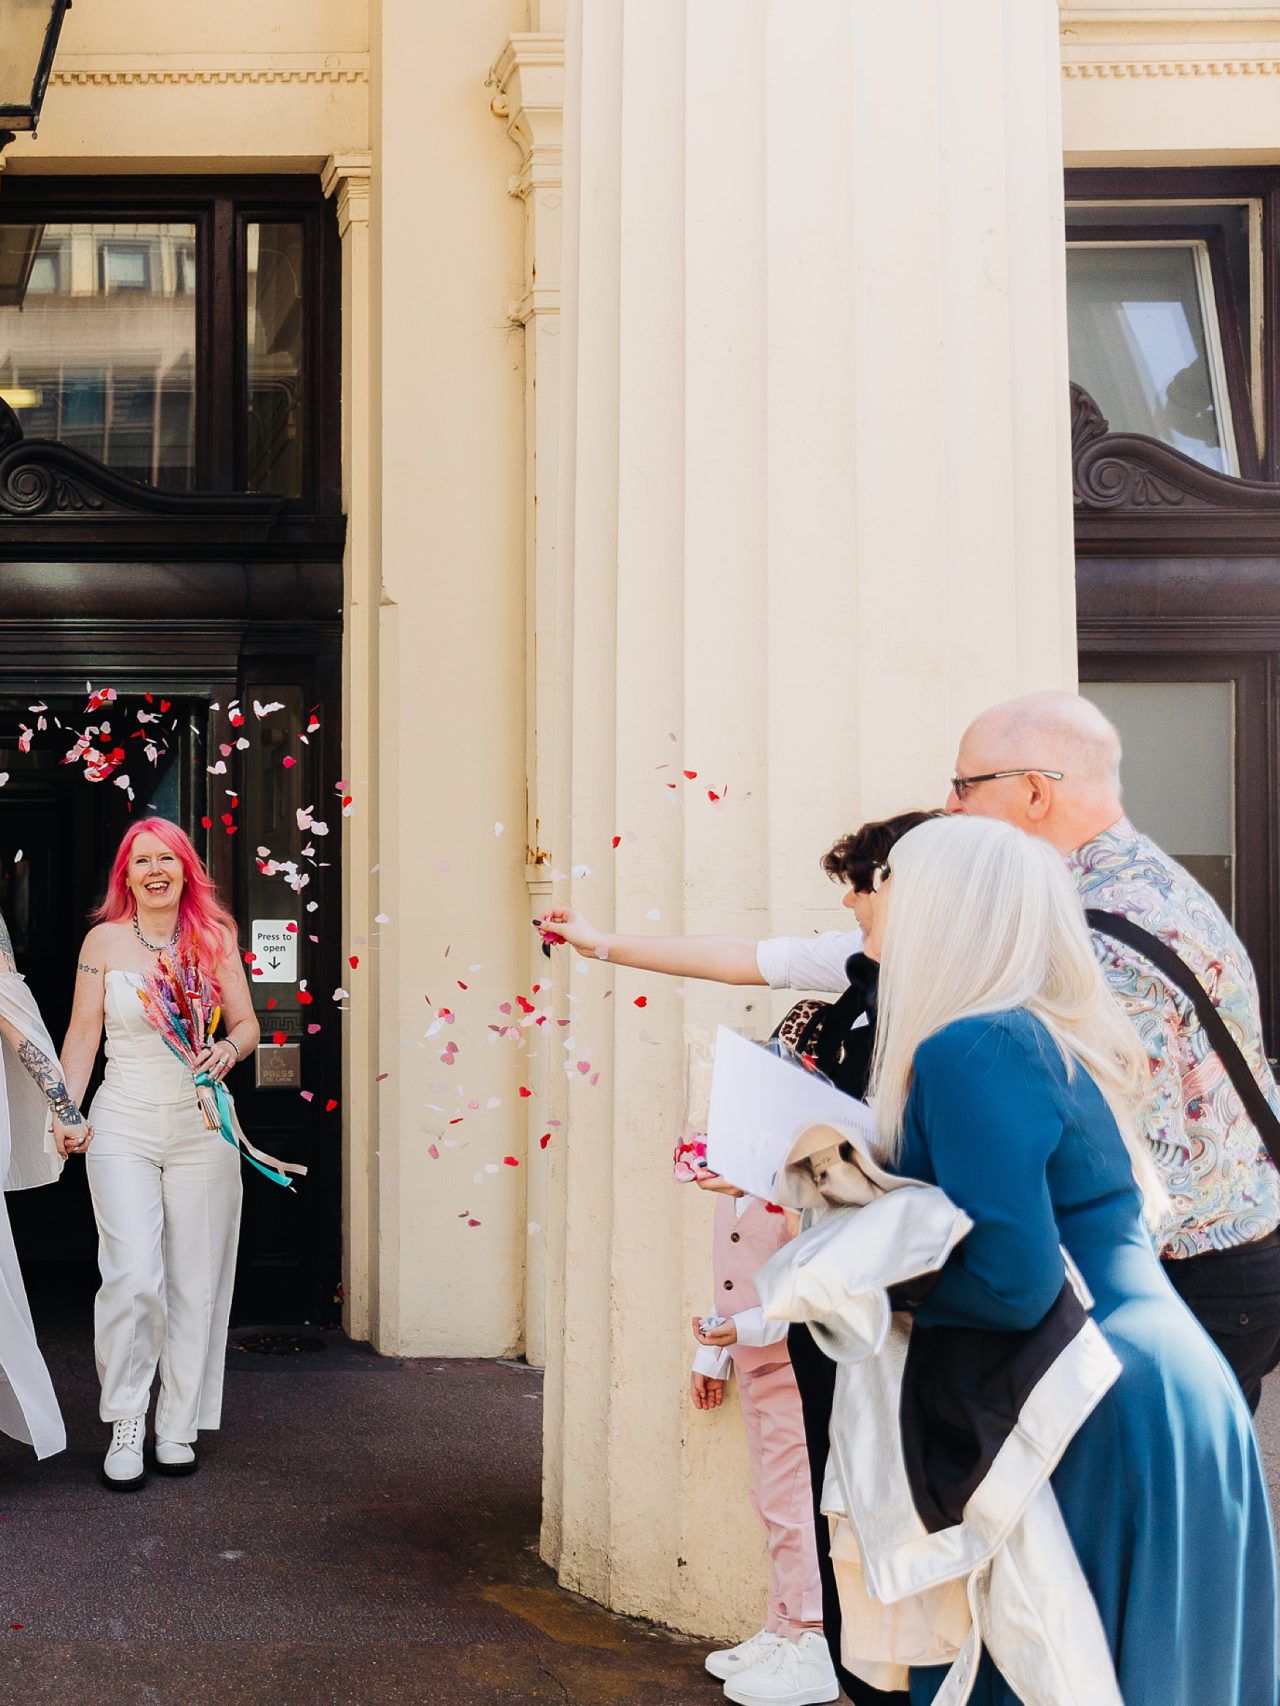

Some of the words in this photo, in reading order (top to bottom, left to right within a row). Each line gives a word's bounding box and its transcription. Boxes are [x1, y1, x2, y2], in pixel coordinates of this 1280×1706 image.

[257, 933, 280, 941] Press
[282, 933, 292, 941] to
[263, 945, 286, 953] open
[262, 1070, 294, 1078] PRESS
